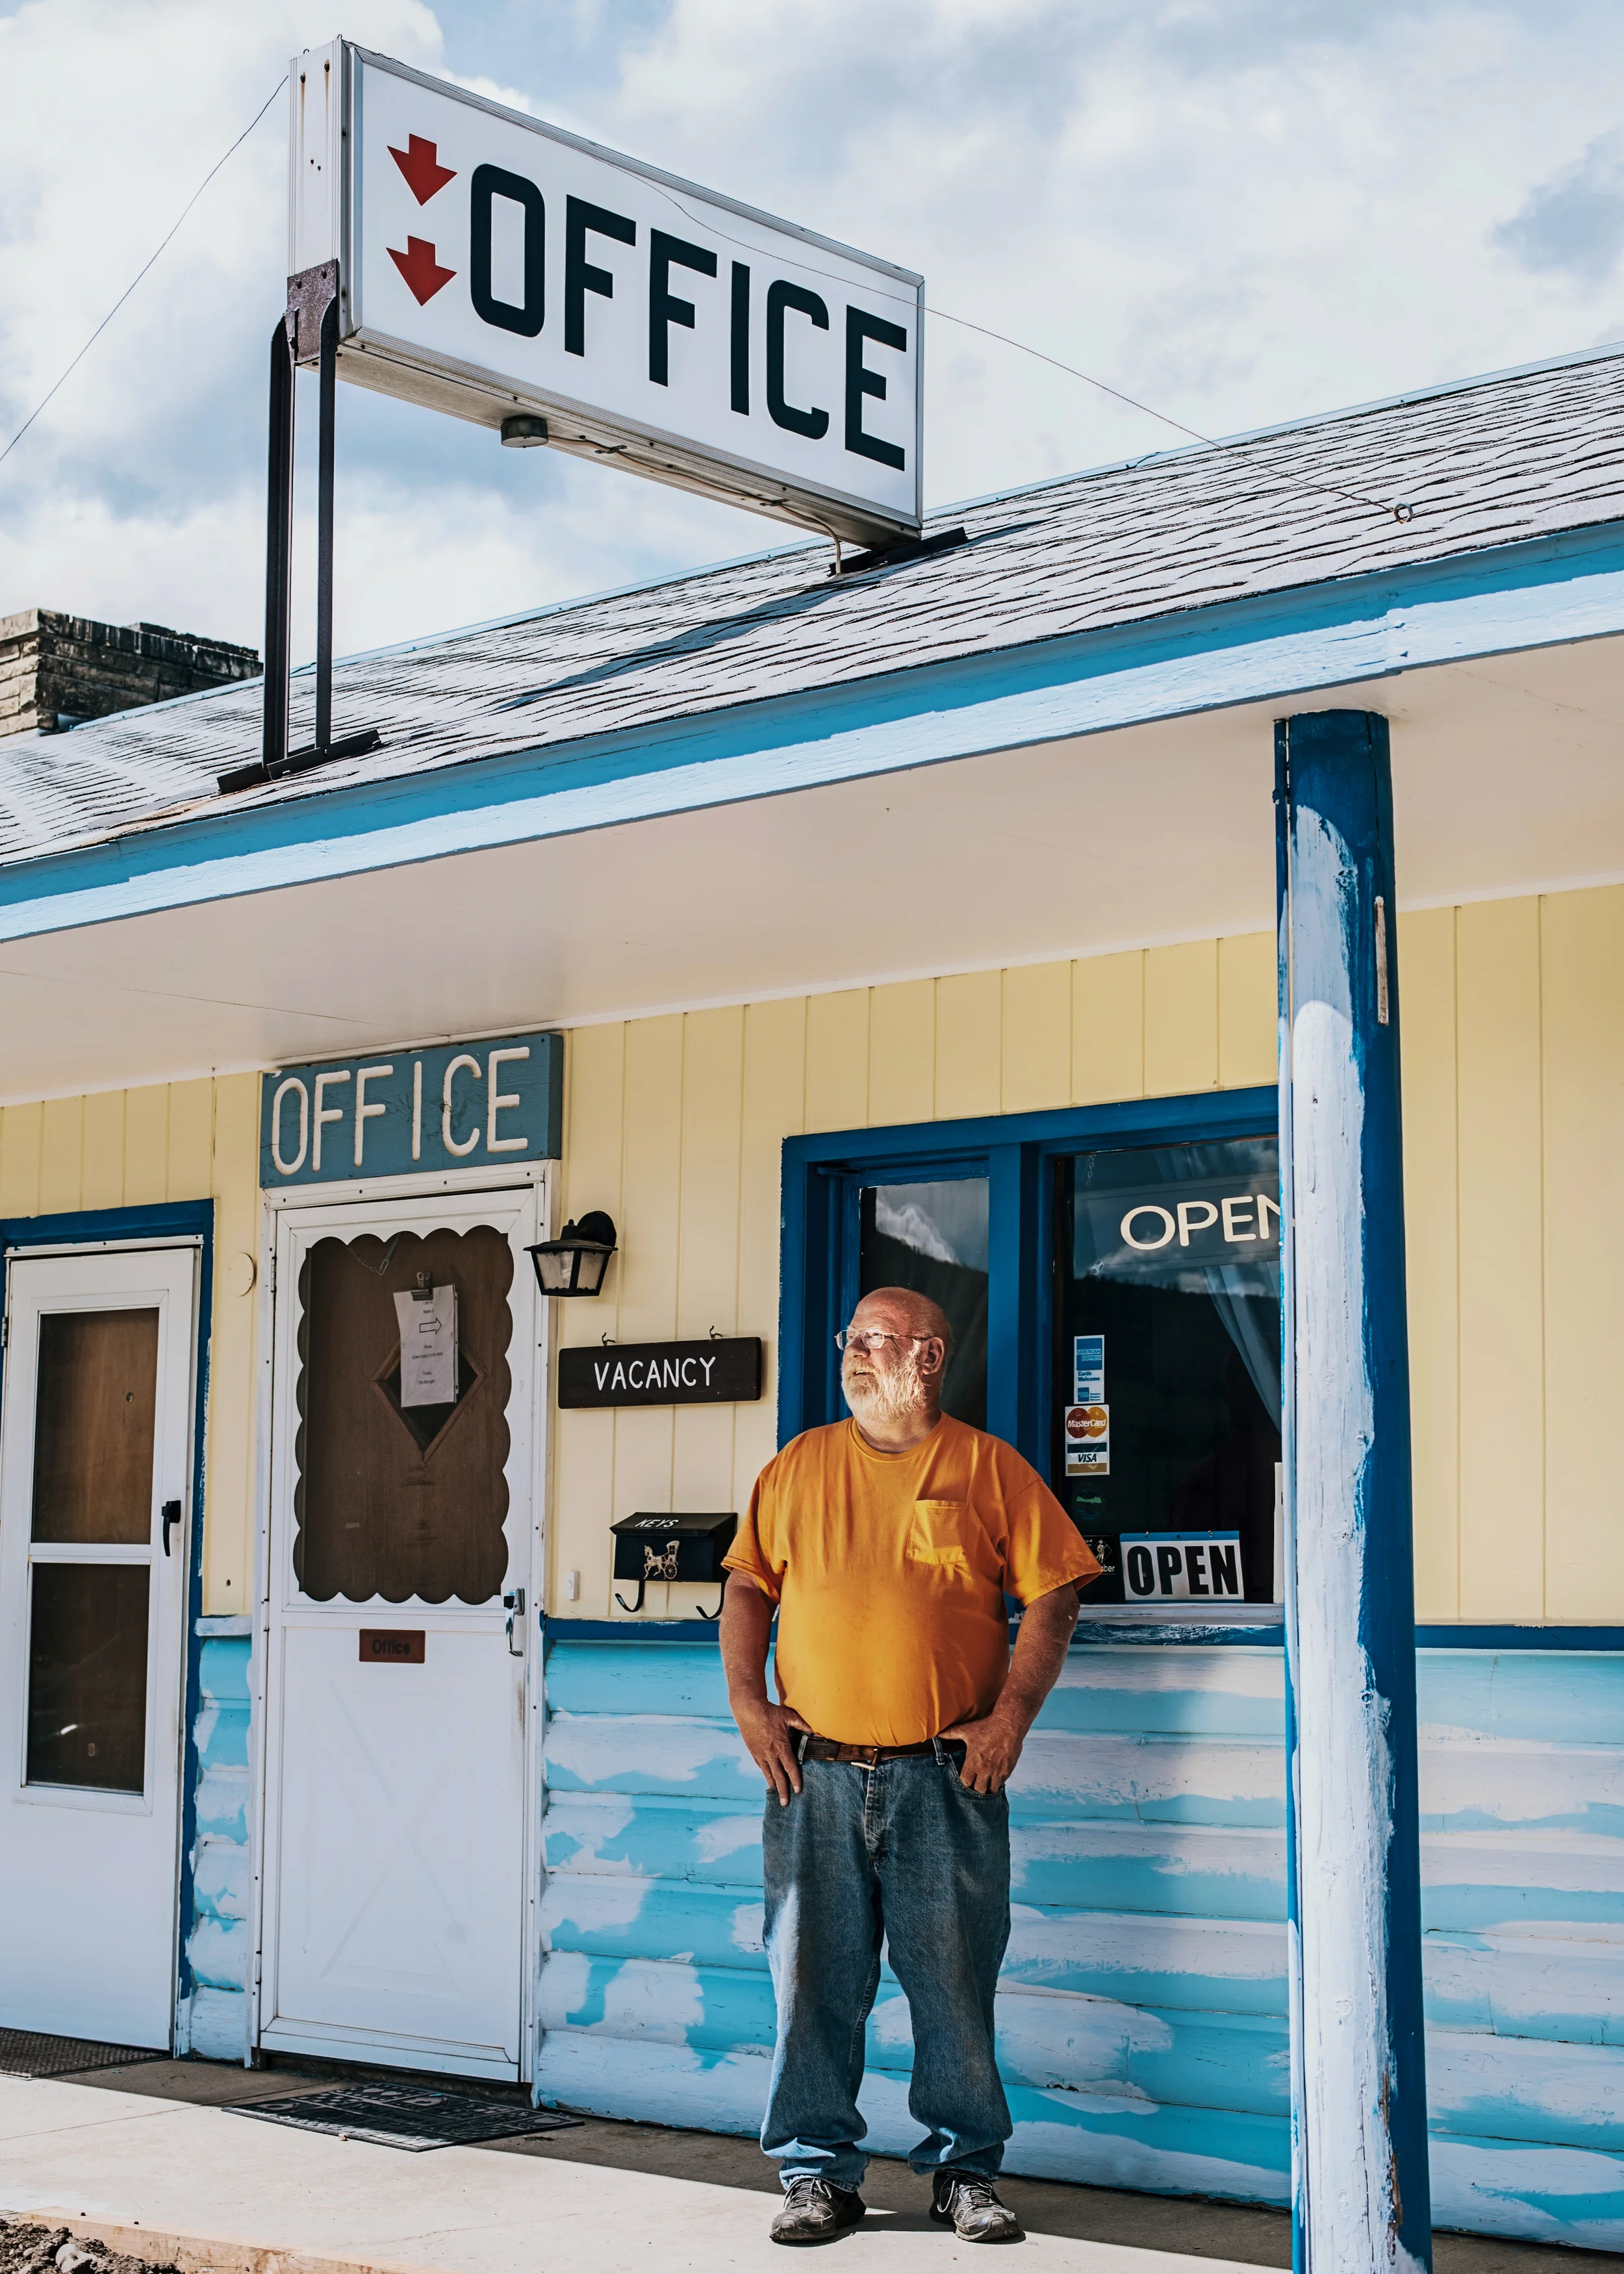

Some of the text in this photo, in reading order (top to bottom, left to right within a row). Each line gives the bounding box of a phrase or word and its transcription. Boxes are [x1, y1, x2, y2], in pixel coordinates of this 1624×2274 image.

[470, 163, 907, 471] OFFICE
[272, 1046, 530, 1175] OFFICE
[594, 1356, 716, 1390] VACANCY
[1067, 1418, 1106, 1428] MasterCard
[1078, 1453, 1097, 1463] VISA
[635, 1518, 679, 1528] KEYS
[1127, 1544, 1239, 1596] OPEN
[372, 1639, 411, 1654] Office
